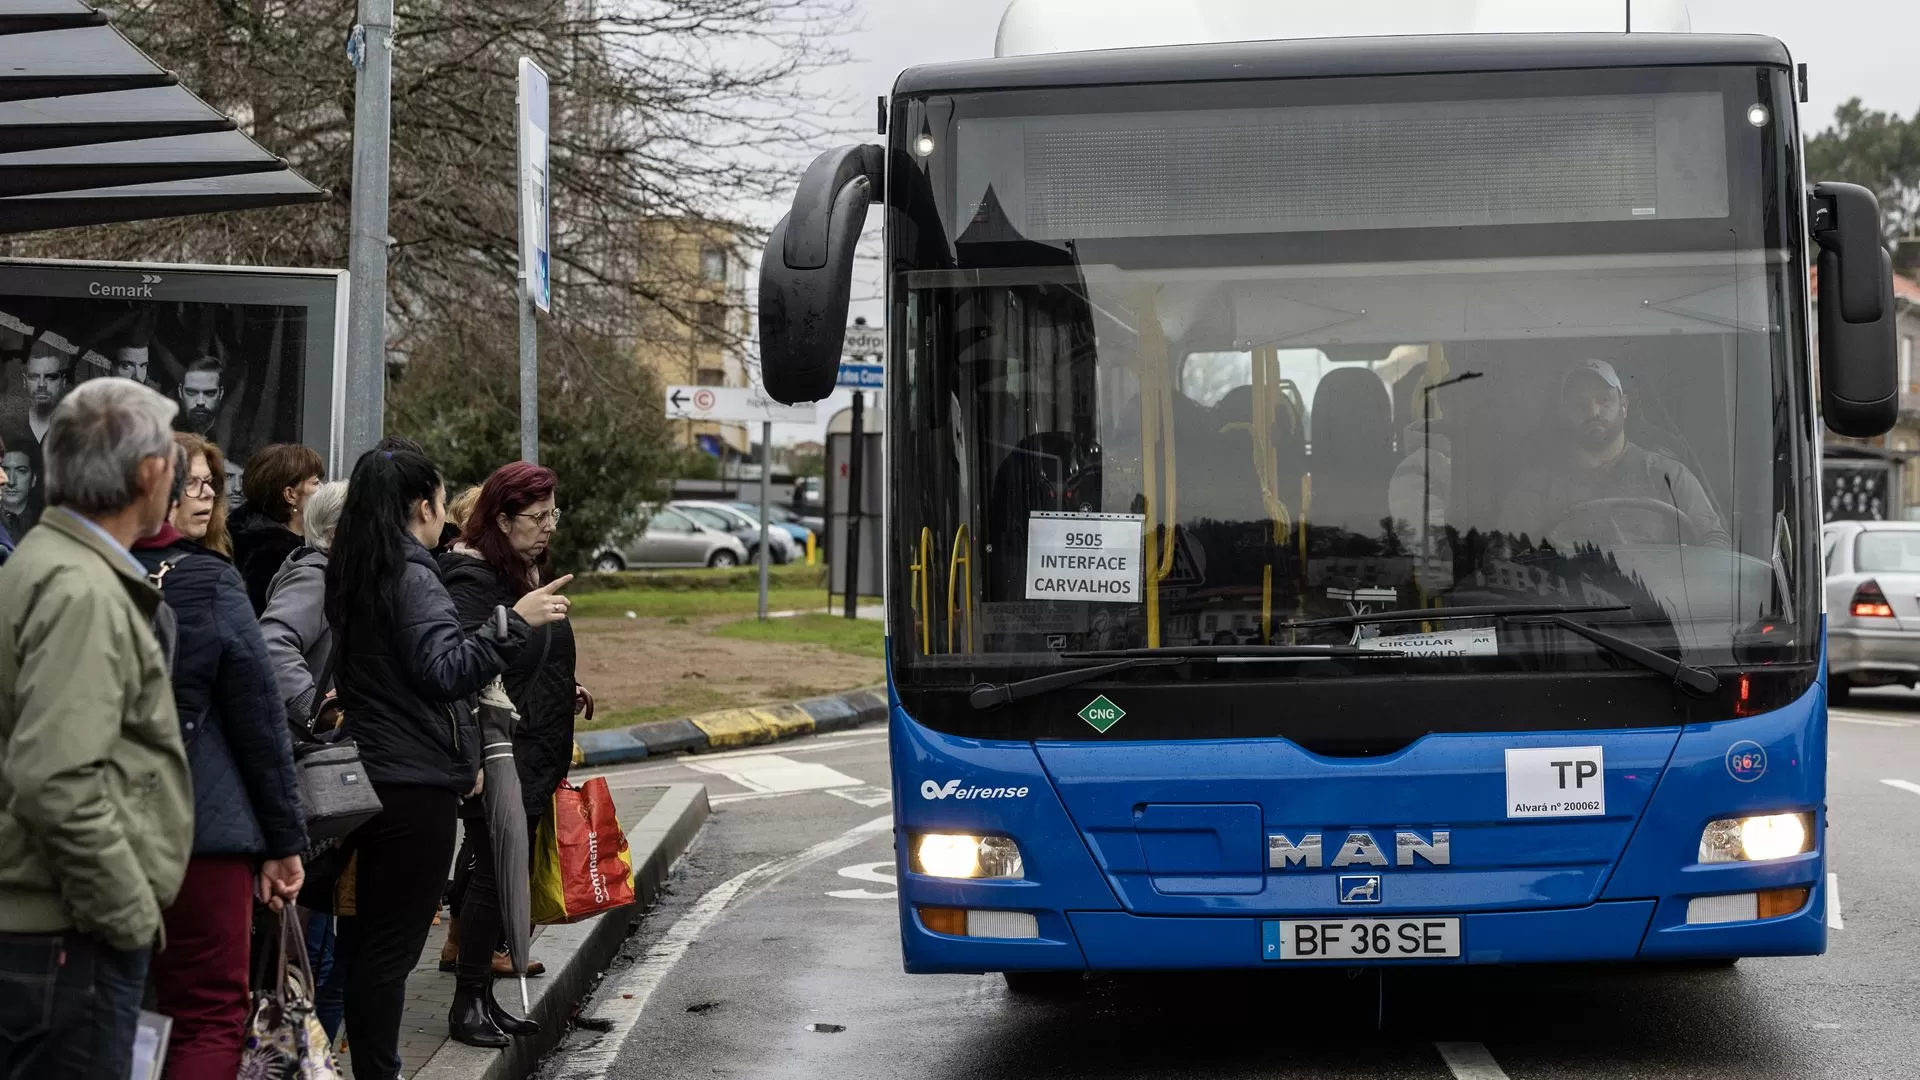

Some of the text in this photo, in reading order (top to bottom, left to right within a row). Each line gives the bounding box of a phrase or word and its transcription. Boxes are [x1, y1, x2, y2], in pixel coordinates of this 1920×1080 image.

[88, 281, 153, 298] Cemark
[1065, 532, 1103, 547] 9505
[1040, 554, 1127, 571] INTERFACE
[1034, 577, 1131, 594] CARVALHOS
[1378, 638, 1454, 648] CIRCULAR
[1088, 708, 1115, 720] CNG
[1731, 754, 1762, 769] 662
[1550, 760, 1598, 789] TP
[1514, 802, 1548, 813] Alvará
[1563, 801, 1600, 812] 200062
[1268, 831, 1450, 868] MAN
[1268, 922, 1447, 955] P BF 36 SE
